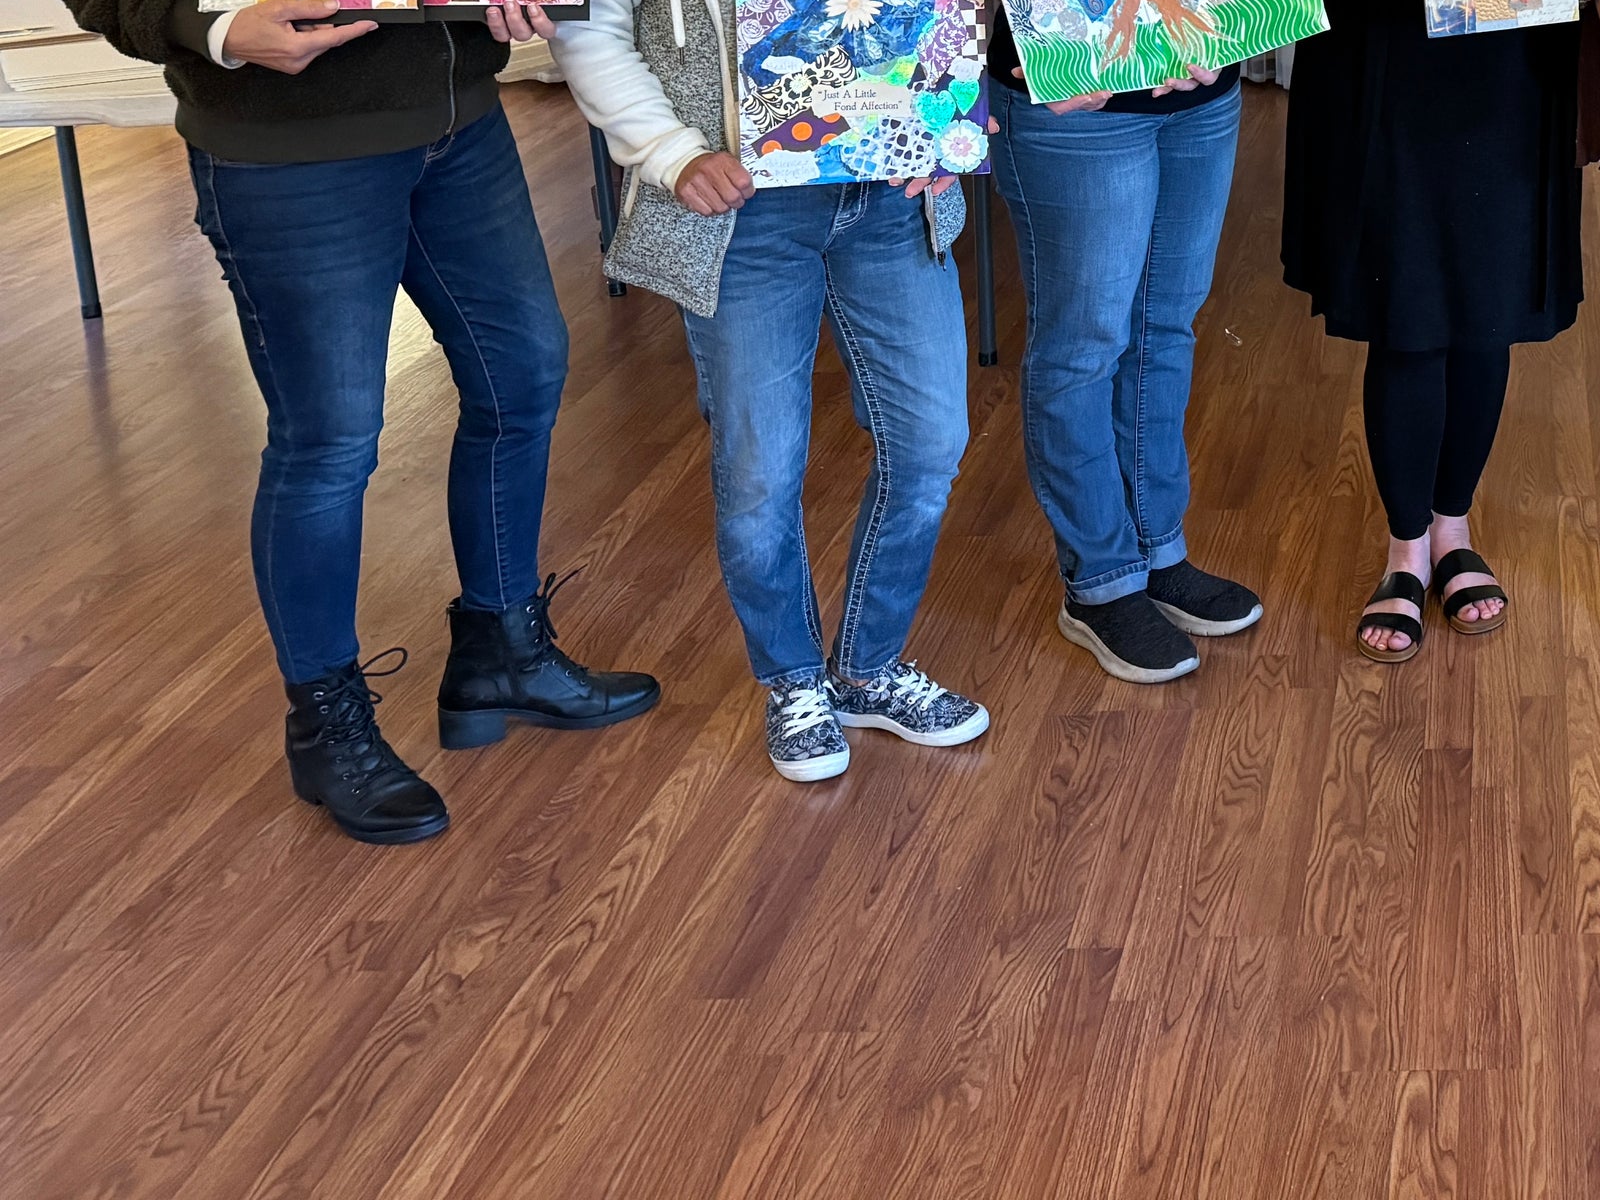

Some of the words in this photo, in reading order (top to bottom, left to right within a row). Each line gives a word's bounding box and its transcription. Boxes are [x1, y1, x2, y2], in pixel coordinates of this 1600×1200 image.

[843, 90, 852, 99] A
[855, 89, 877, 99] Little
[834, 102, 857, 111] Fond
[861, 100, 903, 111] Affection"
